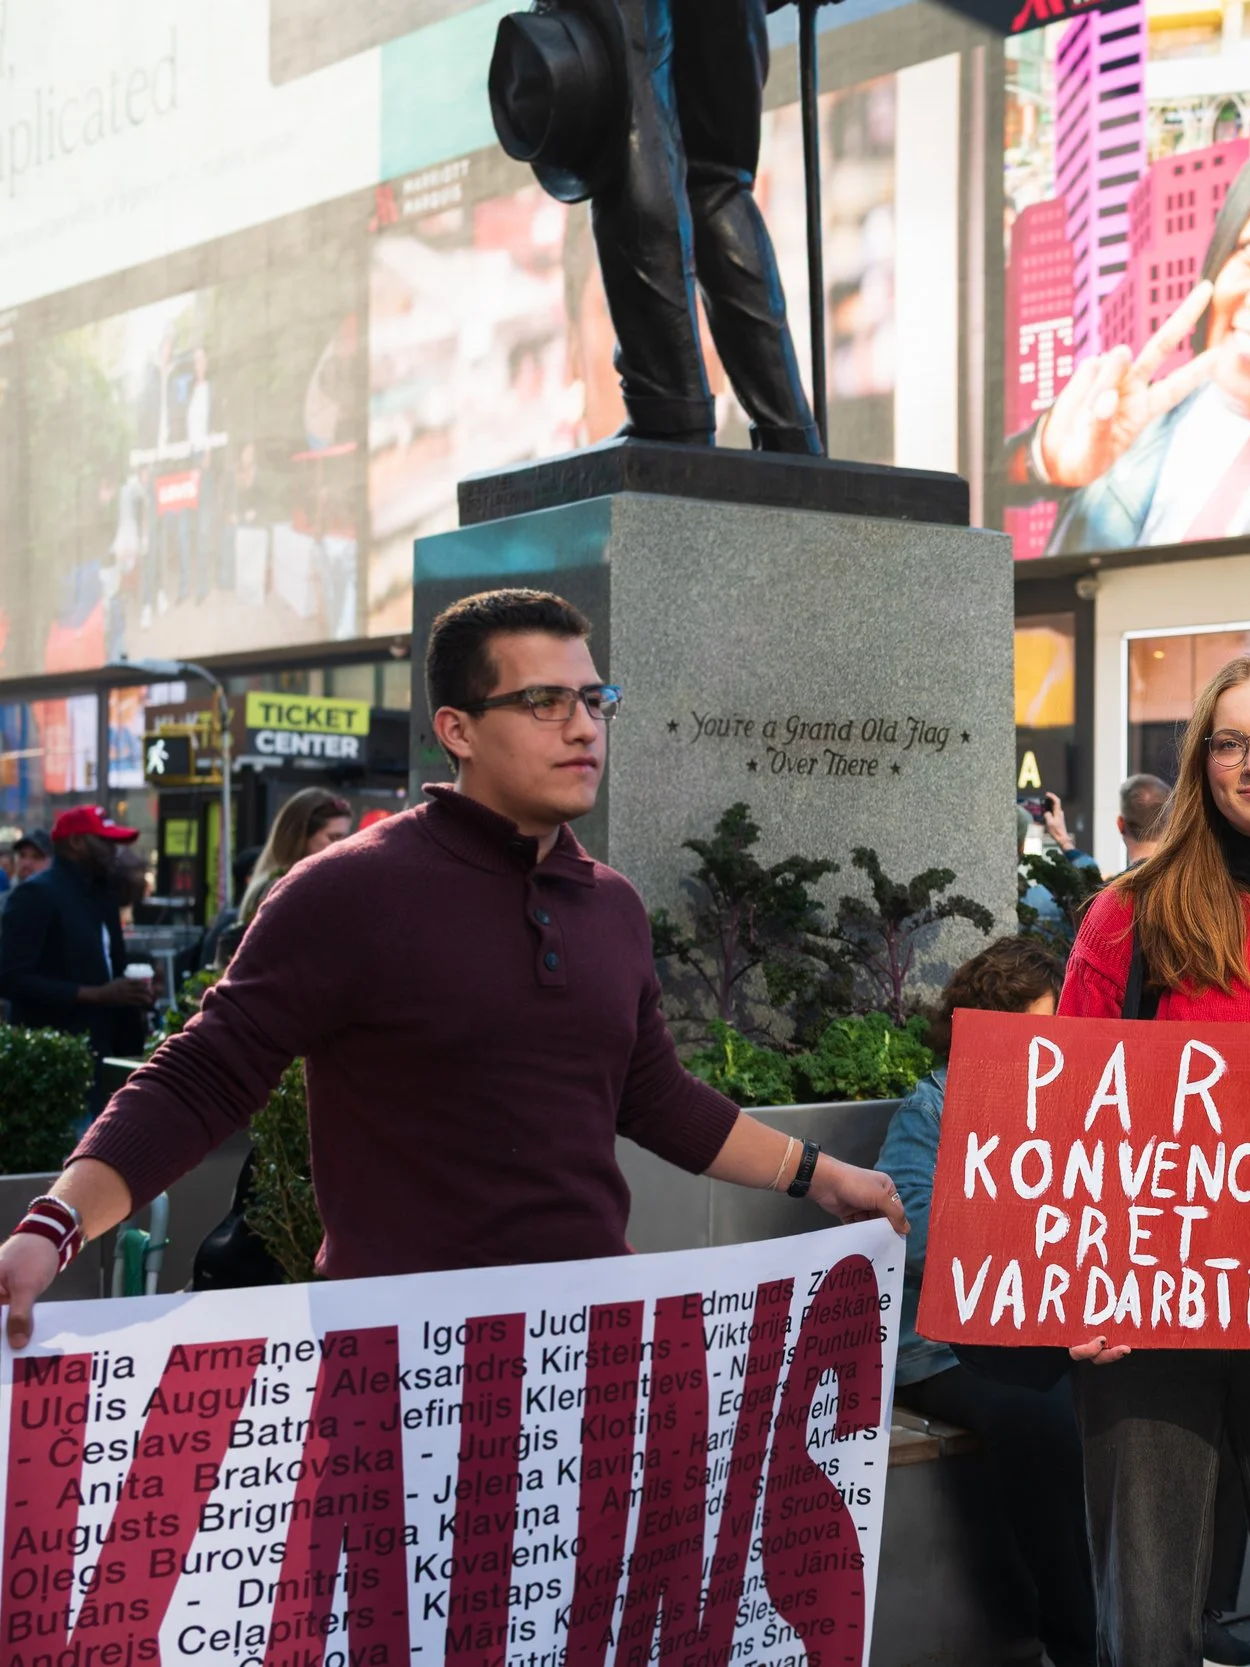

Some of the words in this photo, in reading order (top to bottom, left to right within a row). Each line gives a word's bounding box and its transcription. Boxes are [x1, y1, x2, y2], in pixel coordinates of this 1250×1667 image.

[0, 25, 178, 198] plicated
[255, 730, 359, 758] CENTER
[259, 702, 359, 729] TICKET
[762, 720, 777, 739] a
[784, 715, 851, 745] Grand
[861, 717, 899, 743] Old
[904, 716, 951, 750] Flag
[766, 746, 819, 775] Over
[823, 748, 879, 776] There
[1026, 1035, 1229, 1136] PAR
[1035, 1204, 1209, 1271] PRET
[21, 1393, 126, 1430] Uldis
[142, 1377, 290, 1419] Augulis
[331, 1354, 528, 1398] Aleksandrs
[541, 1339, 670, 1374] Kiršteins
[702, 1314, 792, 1352] Viktorija
[24, 1352, 134, 1388] Maija
[163, 1338, 359, 1374] Armaņeva
[424, 1321, 507, 1354] Igors
[530, 1306, 631, 1338] Judins
[681, 1279, 794, 1320] Edmunds
[49, 1428, 211, 1467] Česlavs
[228, 1414, 338, 1448] Batņa
[380, 1393, 512, 1432] Jefimijs
[526, 1369, 702, 1414] Klementjevs
[730, 1343, 796, 1380] Nauris
[804, 1322, 887, 1360] Puntulis
[56, 1473, 164, 1509] Anita
[193, 1445, 395, 1493] Brakovska
[458, 1425, 558, 1463] Jurģis
[580, 1404, 677, 1444] Klotiņš
[718, 1377, 790, 1416] Edgars
[804, 1362, 856, 1391] Putra
[10, 1511, 180, 1560] Augusts
[198, 1485, 390, 1533] Brigmanis
[434, 1469, 543, 1504] Jeļena
[557, 1448, 661, 1489] Kļaviņa
[758, 1389, 859, 1435] Rokpelnis
[10, 1560, 126, 1603] Oļegs
[150, 1541, 287, 1579] Burovs
[343, 1518, 419, 1555] Līga
[439, 1503, 560, 1543] Kļaviņa
[806, 1424, 878, 1451] Artūrs
[8, 1598, 149, 1644] Butāns
[238, 1562, 380, 1608] Dmitrijs
[414, 1534, 586, 1584] Kovaļenko
[643, 1491, 732, 1537] Edvards
[178, 1609, 374, 1657] Ceļapīters
[424, 1577, 562, 1620] Kristaps
[575, 1534, 703, 1591] Krištopans
[780, 1482, 872, 1522] Sruoģis
[444, 1615, 537, 1655] Māris
[750, 1521, 840, 1563] Stobova
[736, 1588, 817, 1627] Šlesers
[792, 1549, 865, 1577] Jānis
[763, 1616, 835, 1647] Šnore
